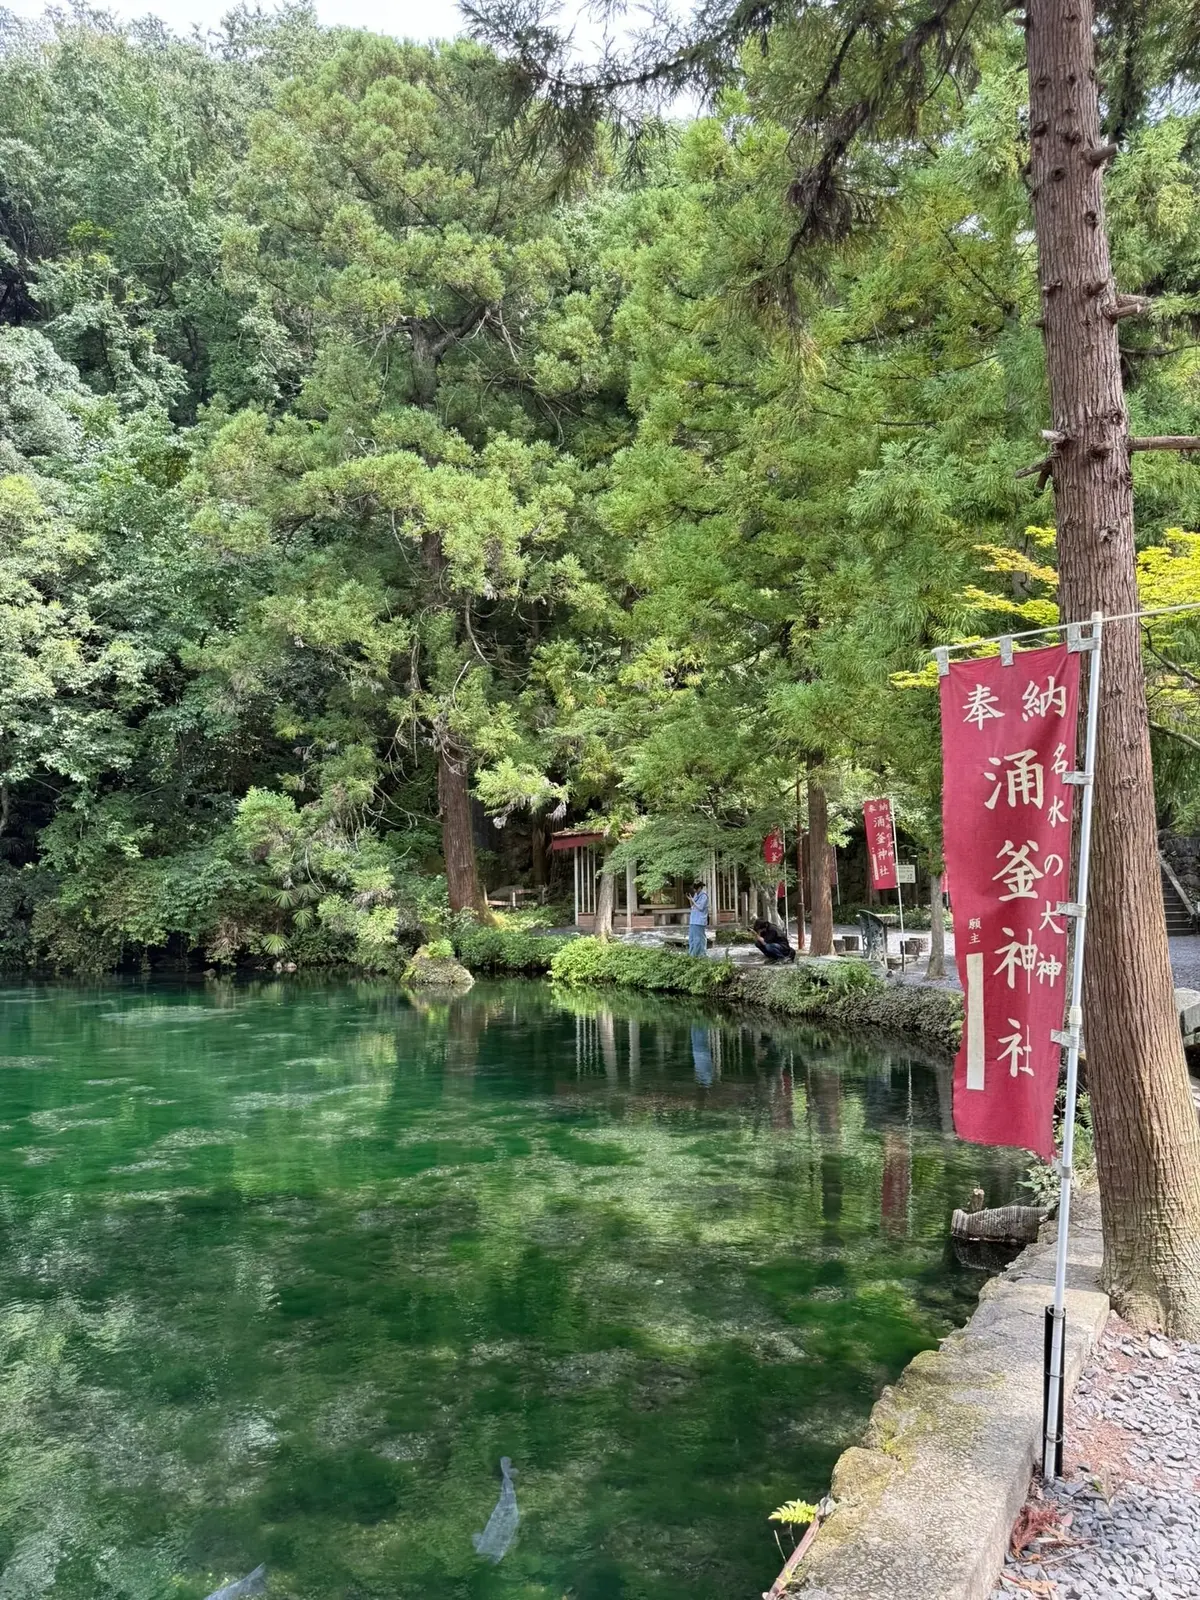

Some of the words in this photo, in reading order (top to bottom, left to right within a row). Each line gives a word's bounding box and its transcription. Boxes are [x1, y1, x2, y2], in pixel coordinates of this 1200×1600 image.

[962, 675, 1067, 731] 奉納
[873, 815, 889, 877] 涌釜神社
[1036, 742, 1069, 988] 名水の大神
[968, 917, 982, 944] 願主
[984, 748, 1044, 1078] 涌釜神社
